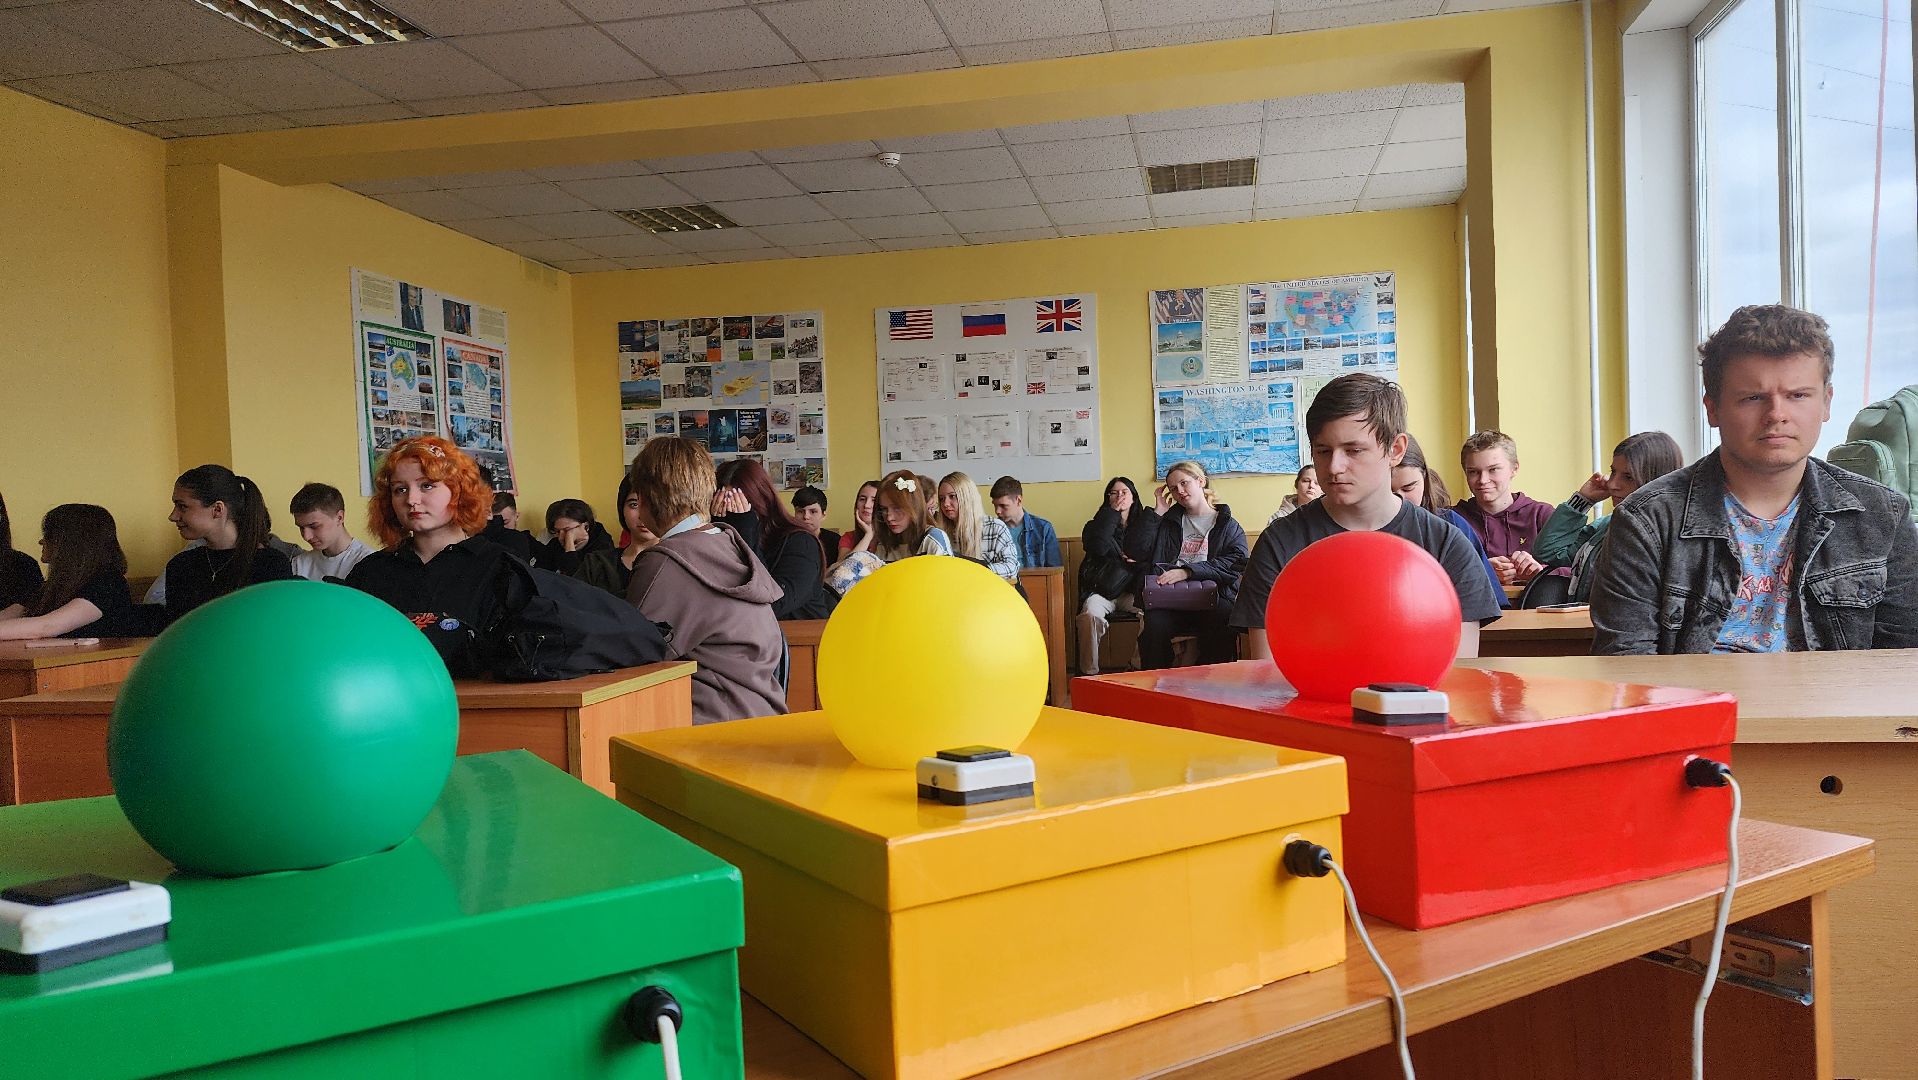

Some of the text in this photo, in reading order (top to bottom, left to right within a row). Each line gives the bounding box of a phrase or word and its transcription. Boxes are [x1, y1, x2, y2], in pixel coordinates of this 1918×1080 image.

[1307, 279, 1330, 287] STATES
[386, 336, 415, 350] AUSTRALIA
[1185, 384, 1266, 396] WASHINGTON D.C.
